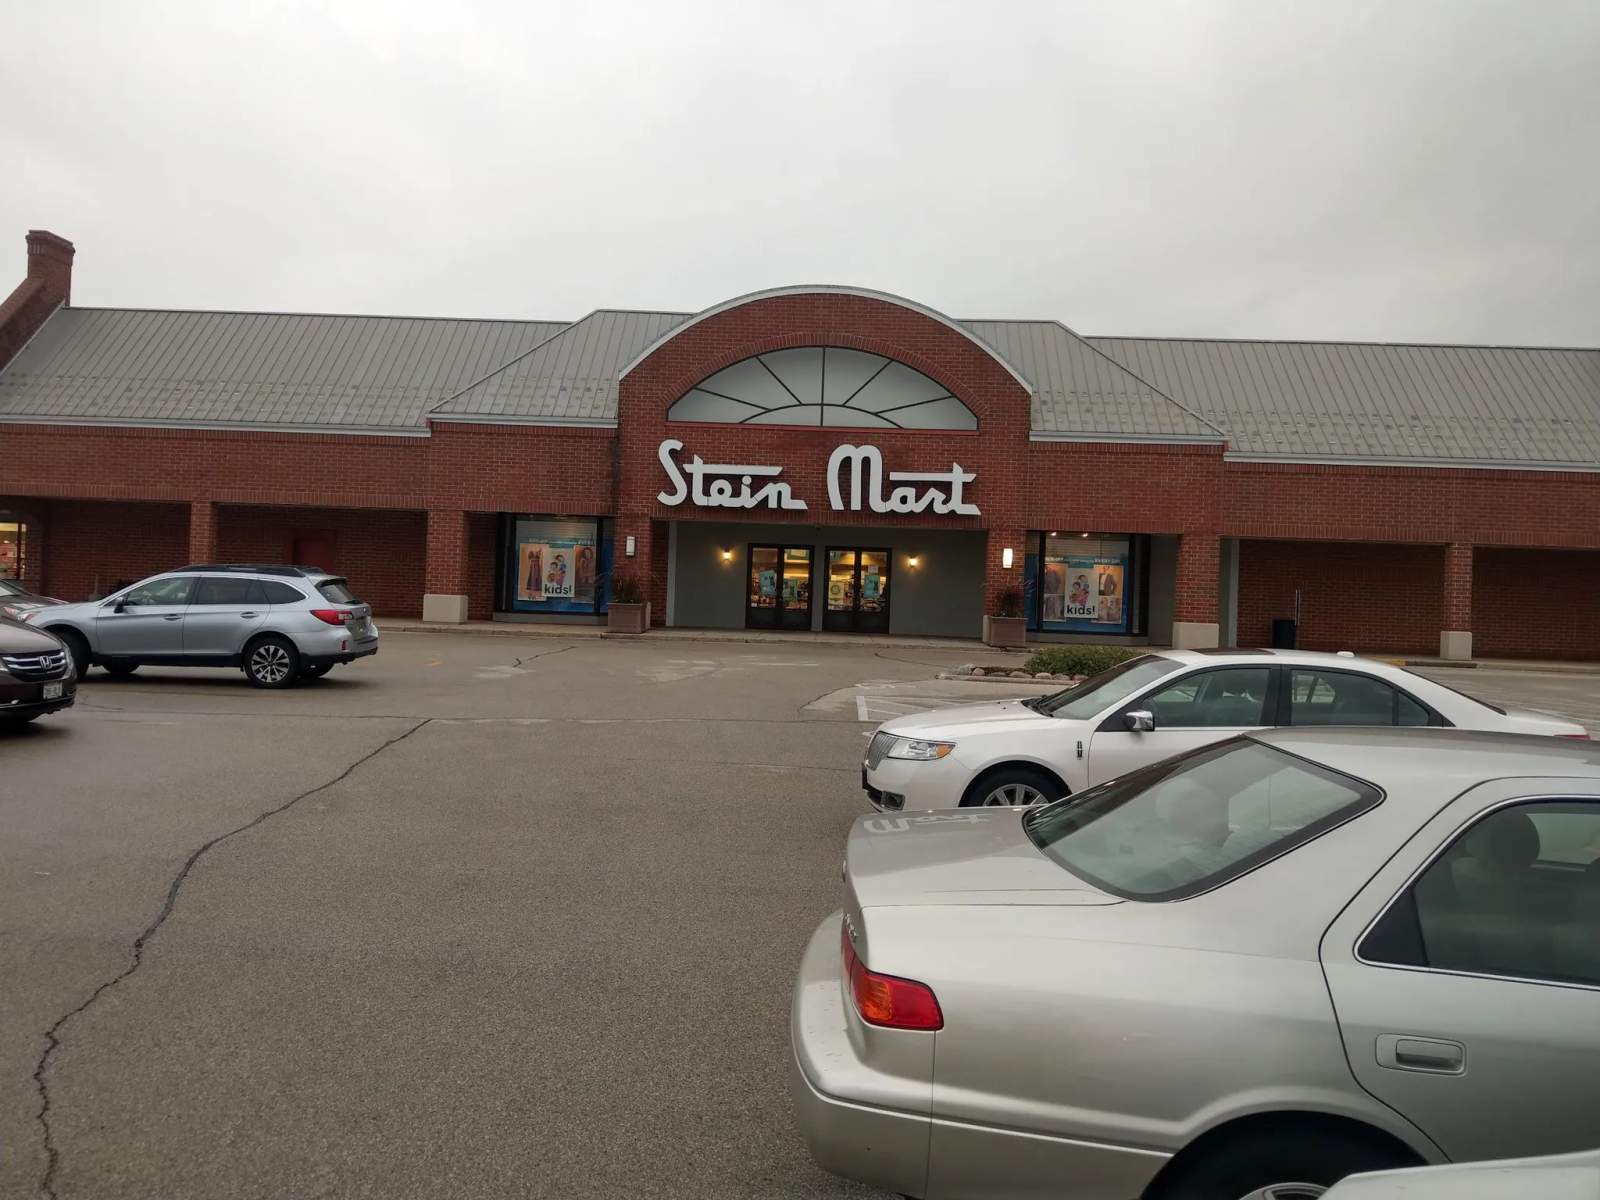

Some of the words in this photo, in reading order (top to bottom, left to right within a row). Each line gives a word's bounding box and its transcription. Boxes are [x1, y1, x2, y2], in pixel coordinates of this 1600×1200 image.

[657, 439, 808, 510] Stein
[827, 444, 982, 515] Mart
[544, 583, 572, 595] kids!
[1066, 604, 1095, 615] kids!
